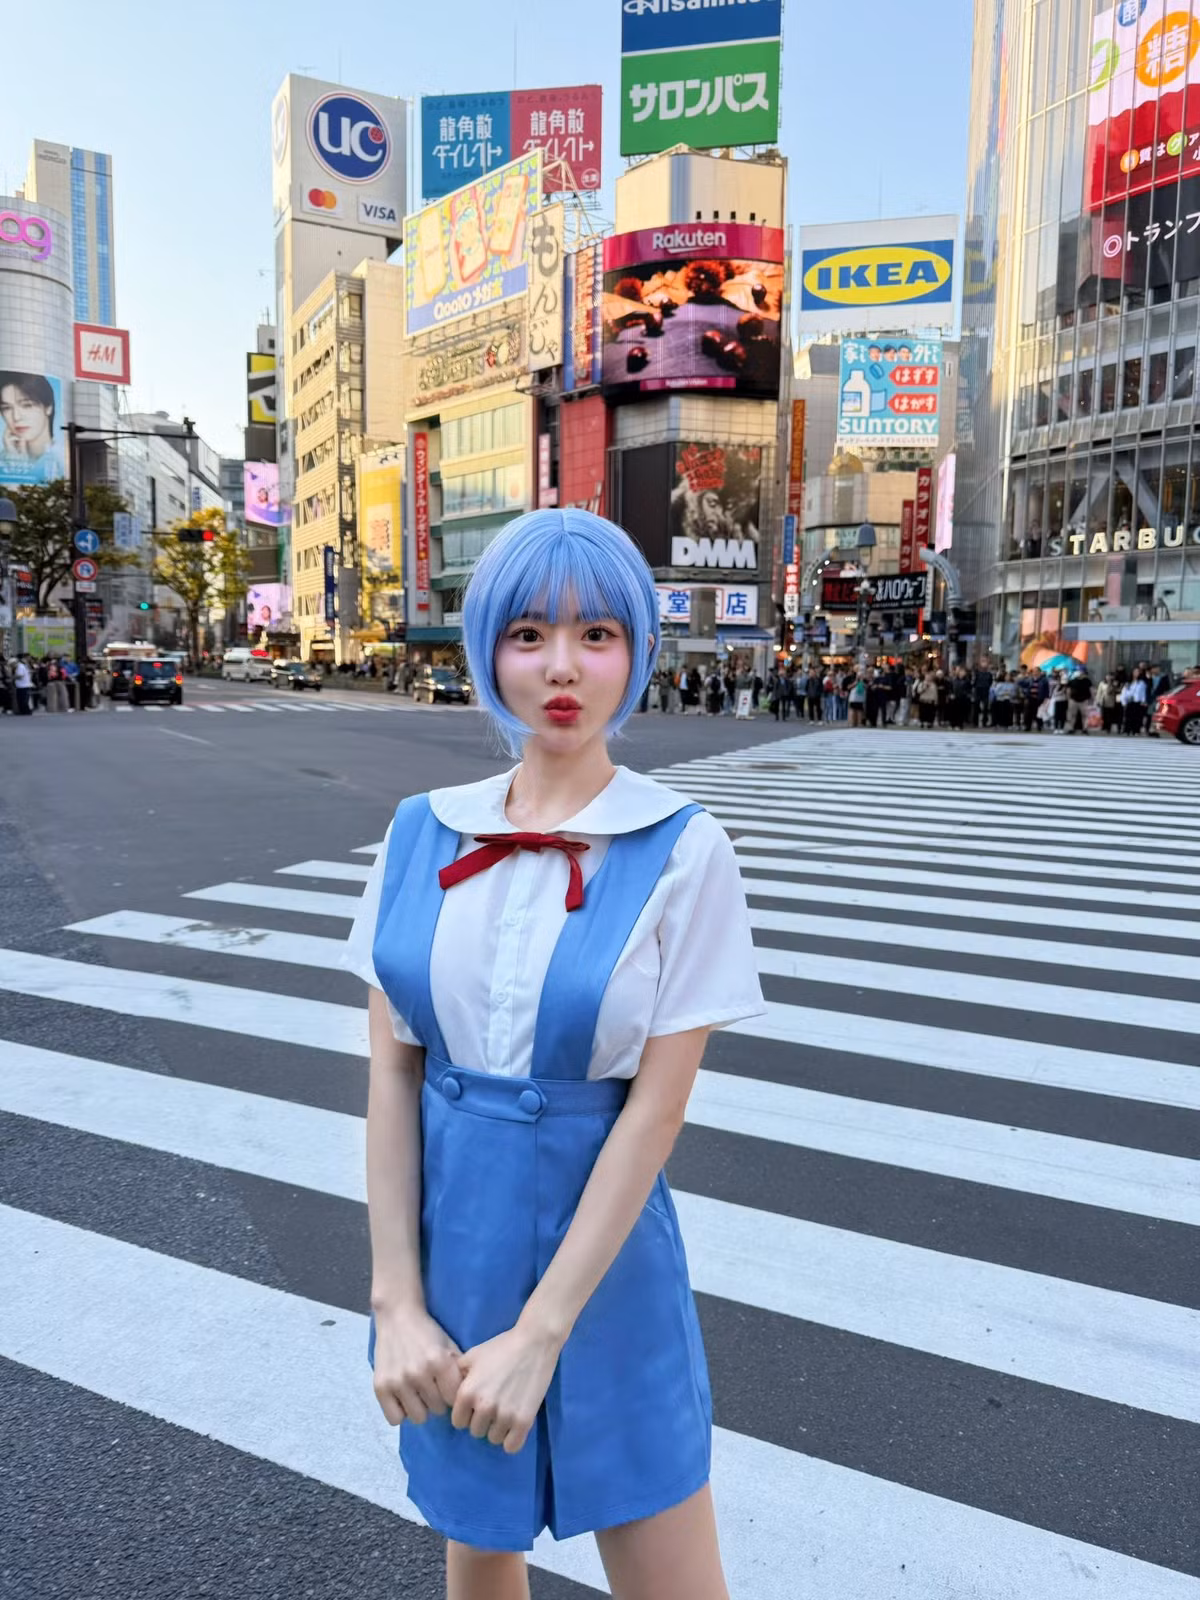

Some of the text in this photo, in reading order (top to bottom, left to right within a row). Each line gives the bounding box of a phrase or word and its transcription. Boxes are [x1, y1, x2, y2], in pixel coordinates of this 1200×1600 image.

[1146, 25, 1188, 78] 糖
[629, 72, 769, 122] サロンパス
[439, 114, 493, 142] 龍角散
[530, 108, 585, 136] 龍角散
[318, 112, 384, 163] UC
[362, 202, 397, 222] VISA
[652, 230, 726, 251] Rakuten
[530, 213, 560, 361] もんじゃ
[817, 261, 939, 290] IKEA
[671, 536, 757, 568] DMM
[657, 591, 690, 614] 堂
